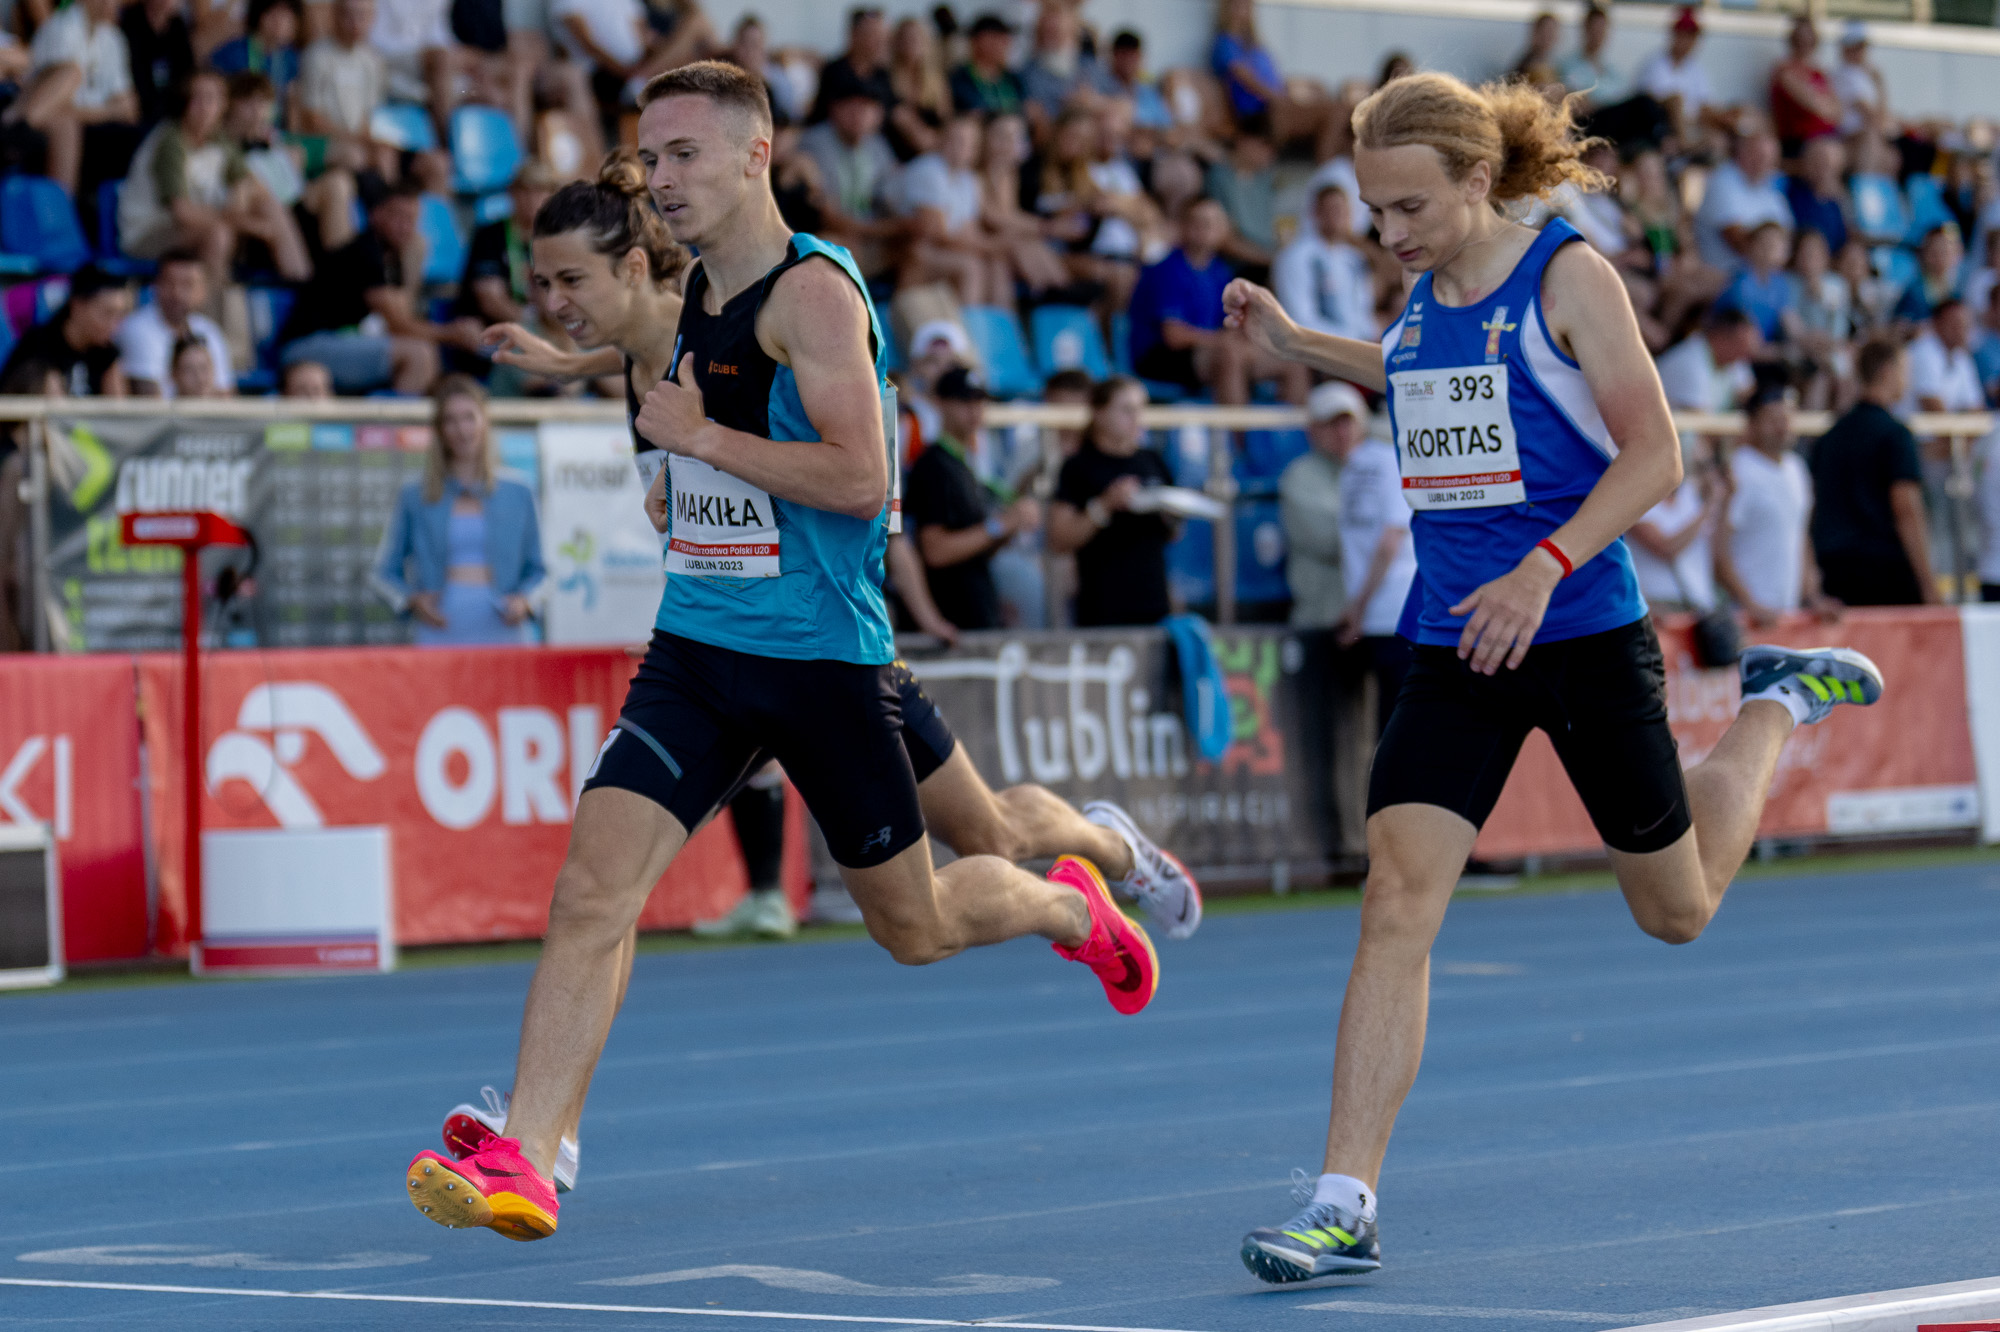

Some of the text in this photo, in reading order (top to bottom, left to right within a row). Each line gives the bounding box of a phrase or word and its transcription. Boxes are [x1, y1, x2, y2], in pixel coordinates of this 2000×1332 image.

[713, 363, 739, 375] CUBE
[1448, 374, 1494, 402] 393
[1406, 423, 1503, 458] KORTAS
[1429, 476, 1470, 487] Mistrzostwa
[1471, 474, 1493, 485] Polski
[1494, 473, 1511, 483] U20
[1427, 490, 1485, 503] LUBLIN 2023
[675, 489, 763, 528] MAKIŁA
[690, 545, 728, 555] Mistrzostwa
[729, 546, 753, 555] Polski
[754, 546, 770, 554] U20
[684, 559, 743, 571] LUBLIN 2023
